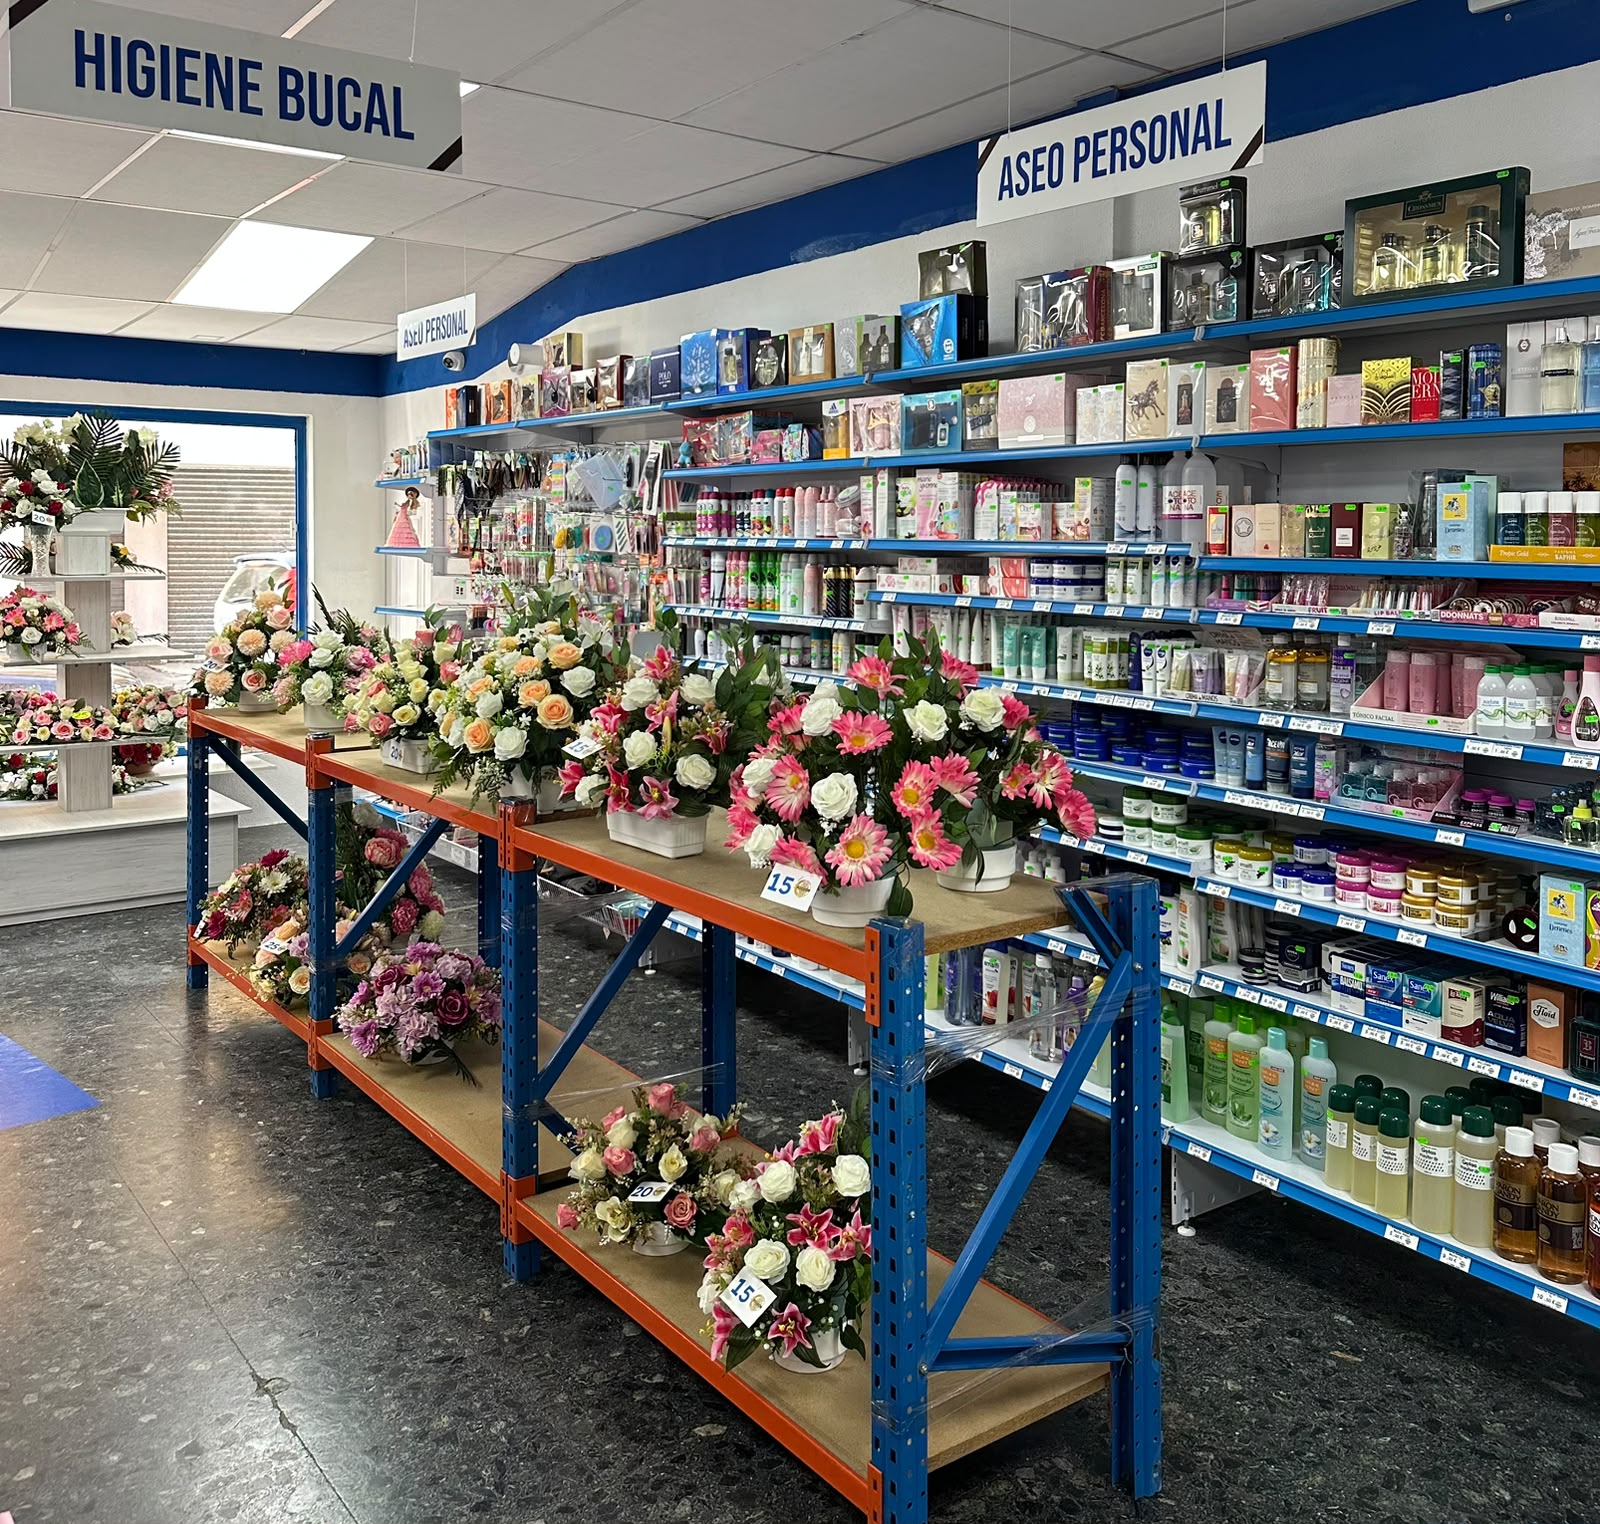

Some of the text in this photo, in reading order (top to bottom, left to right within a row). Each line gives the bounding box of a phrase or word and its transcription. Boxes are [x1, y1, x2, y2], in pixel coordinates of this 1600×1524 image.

[74, 29, 415, 141] HIGIENE BUCAL
[998, 98, 1232, 201] ASEO PERSONAL
[403, 308, 468, 349] ASEO PERSONAL
[658, 370, 672, 381] POLO
[34, 514, 46, 523] 20
[1440, 611, 1484, 621] DDONNATS
[1352, 710, 1395, 722] TÓNICO FACIAL
[569, 741, 586, 752] 15
[767, 873, 794, 895] 15
[264, 941, 278, 950] 25
[1488, 1010, 1516, 1023] AQUA
[631, 1186, 652, 1198] 20
[731, 1278, 755, 1303] 15
